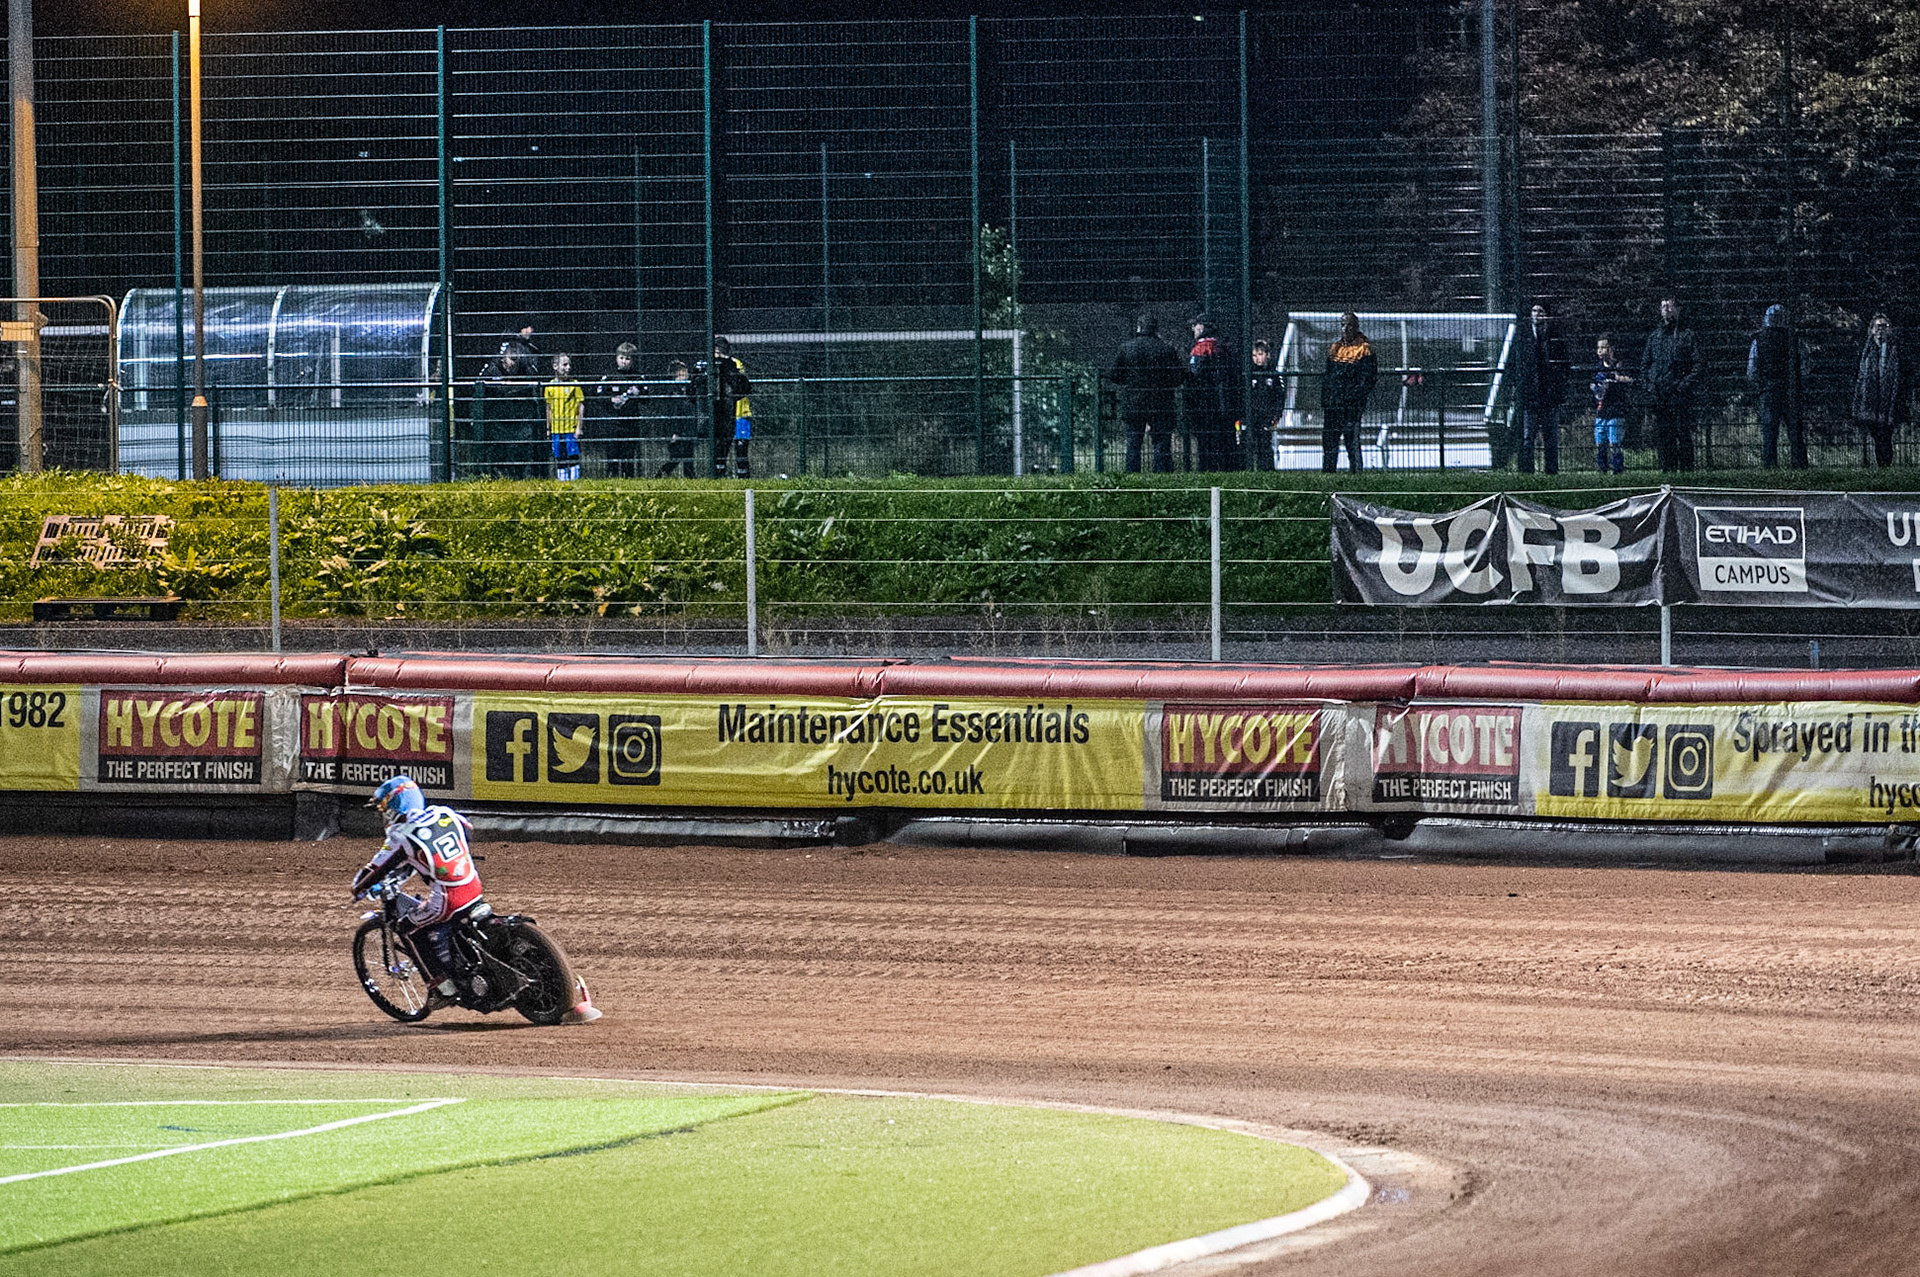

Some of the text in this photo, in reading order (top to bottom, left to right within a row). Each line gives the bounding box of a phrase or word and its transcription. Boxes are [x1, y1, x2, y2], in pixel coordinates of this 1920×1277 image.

[1705, 525, 1797, 545] ETIHAD
[1887, 512, 1920, 546] U
[1375, 507, 1622, 595] UCFB
[1715, 564, 1790, 584] CAMPUS
[0, 691, 66, 728] 982
[107, 699, 256, 748] HYCOTE
[308, 702, 447, 753] HYCOTE
[718, 704, 1090, 744] Maintenance Essentials
[1169, 713, 1313, 764] HYCOTE
[1379, 713, 1515, 766] HYCOTE
[1734, 711, 1853, 762] Sprayed
[1863, 712, 1890, 753] in
[107, 761, 253, 779] THE PERFECT FINISH
[305, 762, 336, 780] THE
[828, 764, 984, 801] hycote.co.uk
[1169, 778, 1311, 798] THE PERFECT FINISH
[1379, 778, 1511, 800] THE PERFECT FINISH
[438, 836, 460, 859] 2
